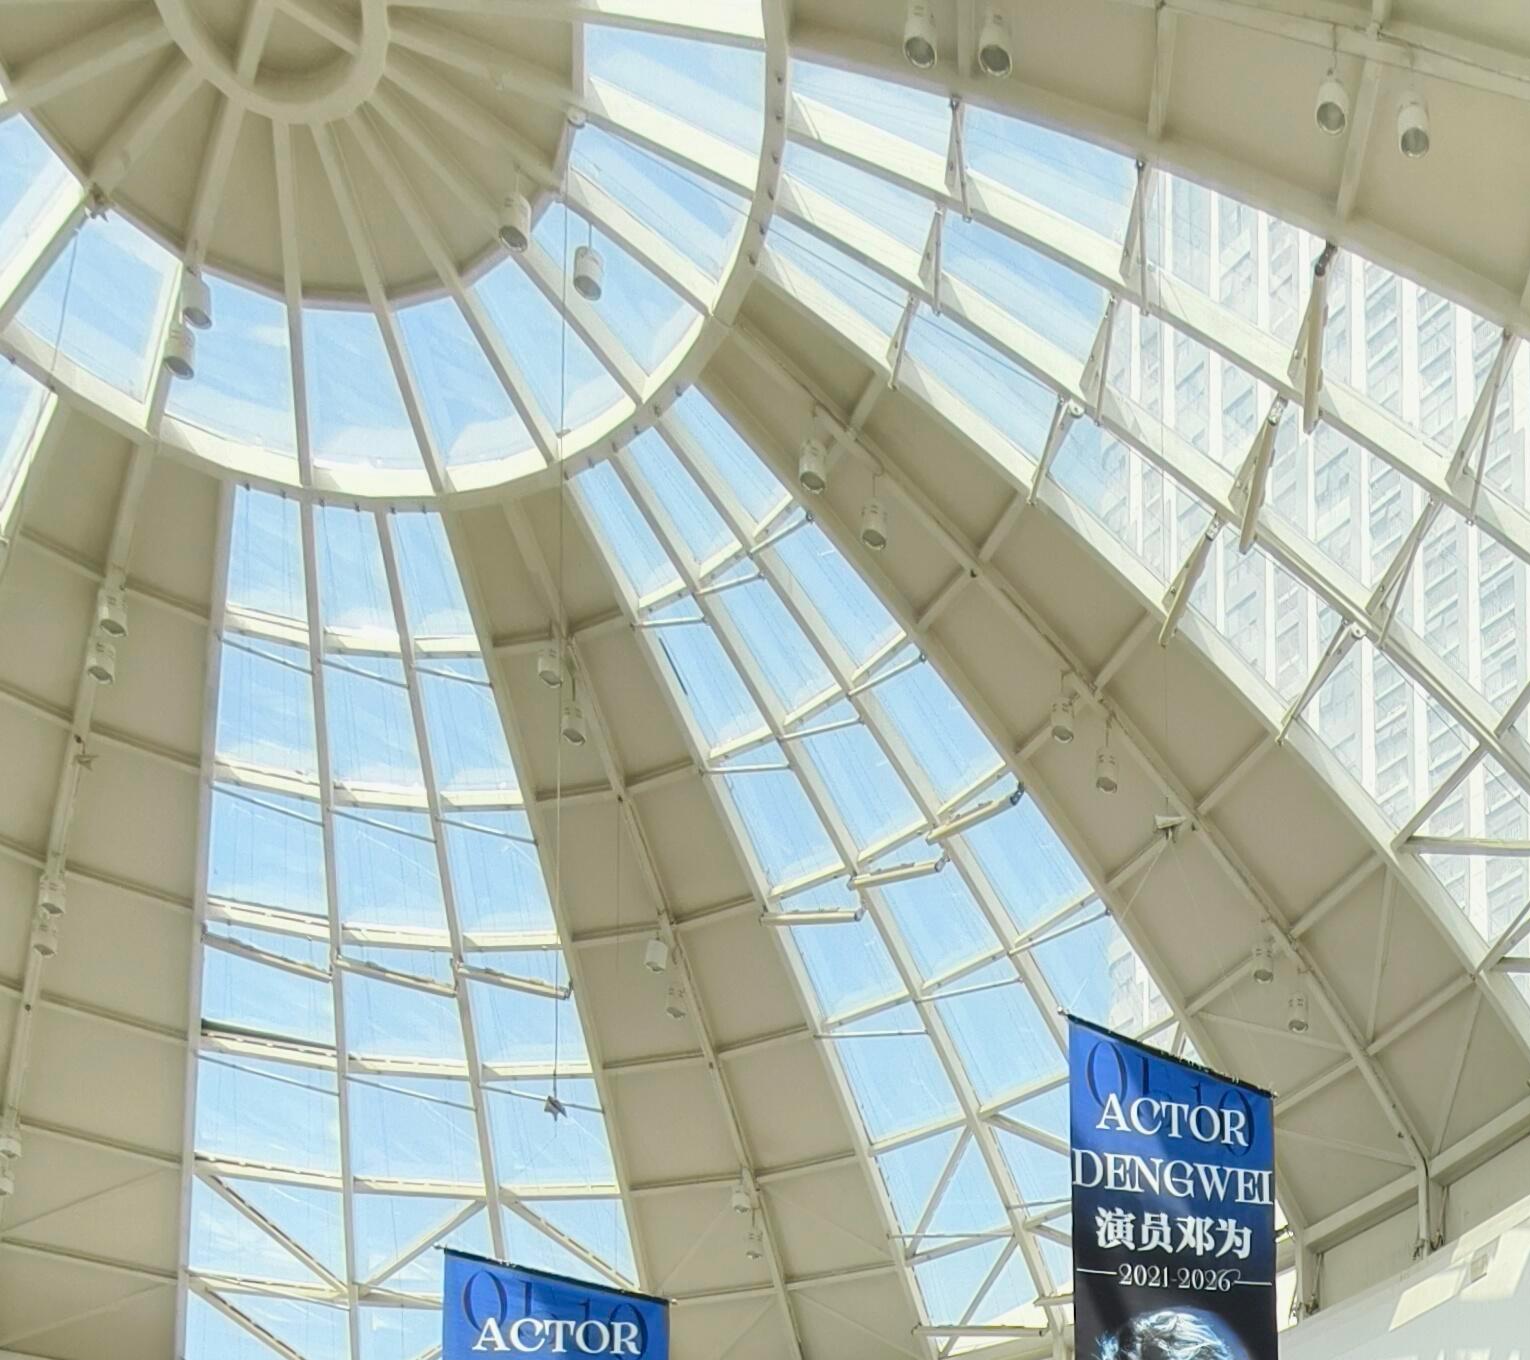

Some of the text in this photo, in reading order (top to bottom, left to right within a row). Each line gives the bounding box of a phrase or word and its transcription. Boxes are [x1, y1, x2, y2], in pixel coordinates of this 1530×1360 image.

[1096, 1093, 1249, 1146] ACTOR
[1072, 1148, 1273, 1205] DENGWEI
[1095, 1207, 1252, 1259] 演员邓为
[1118, 1264, 1240, 1292] 2021-2026
[472, 1318, 640, 1355] ACTOR
